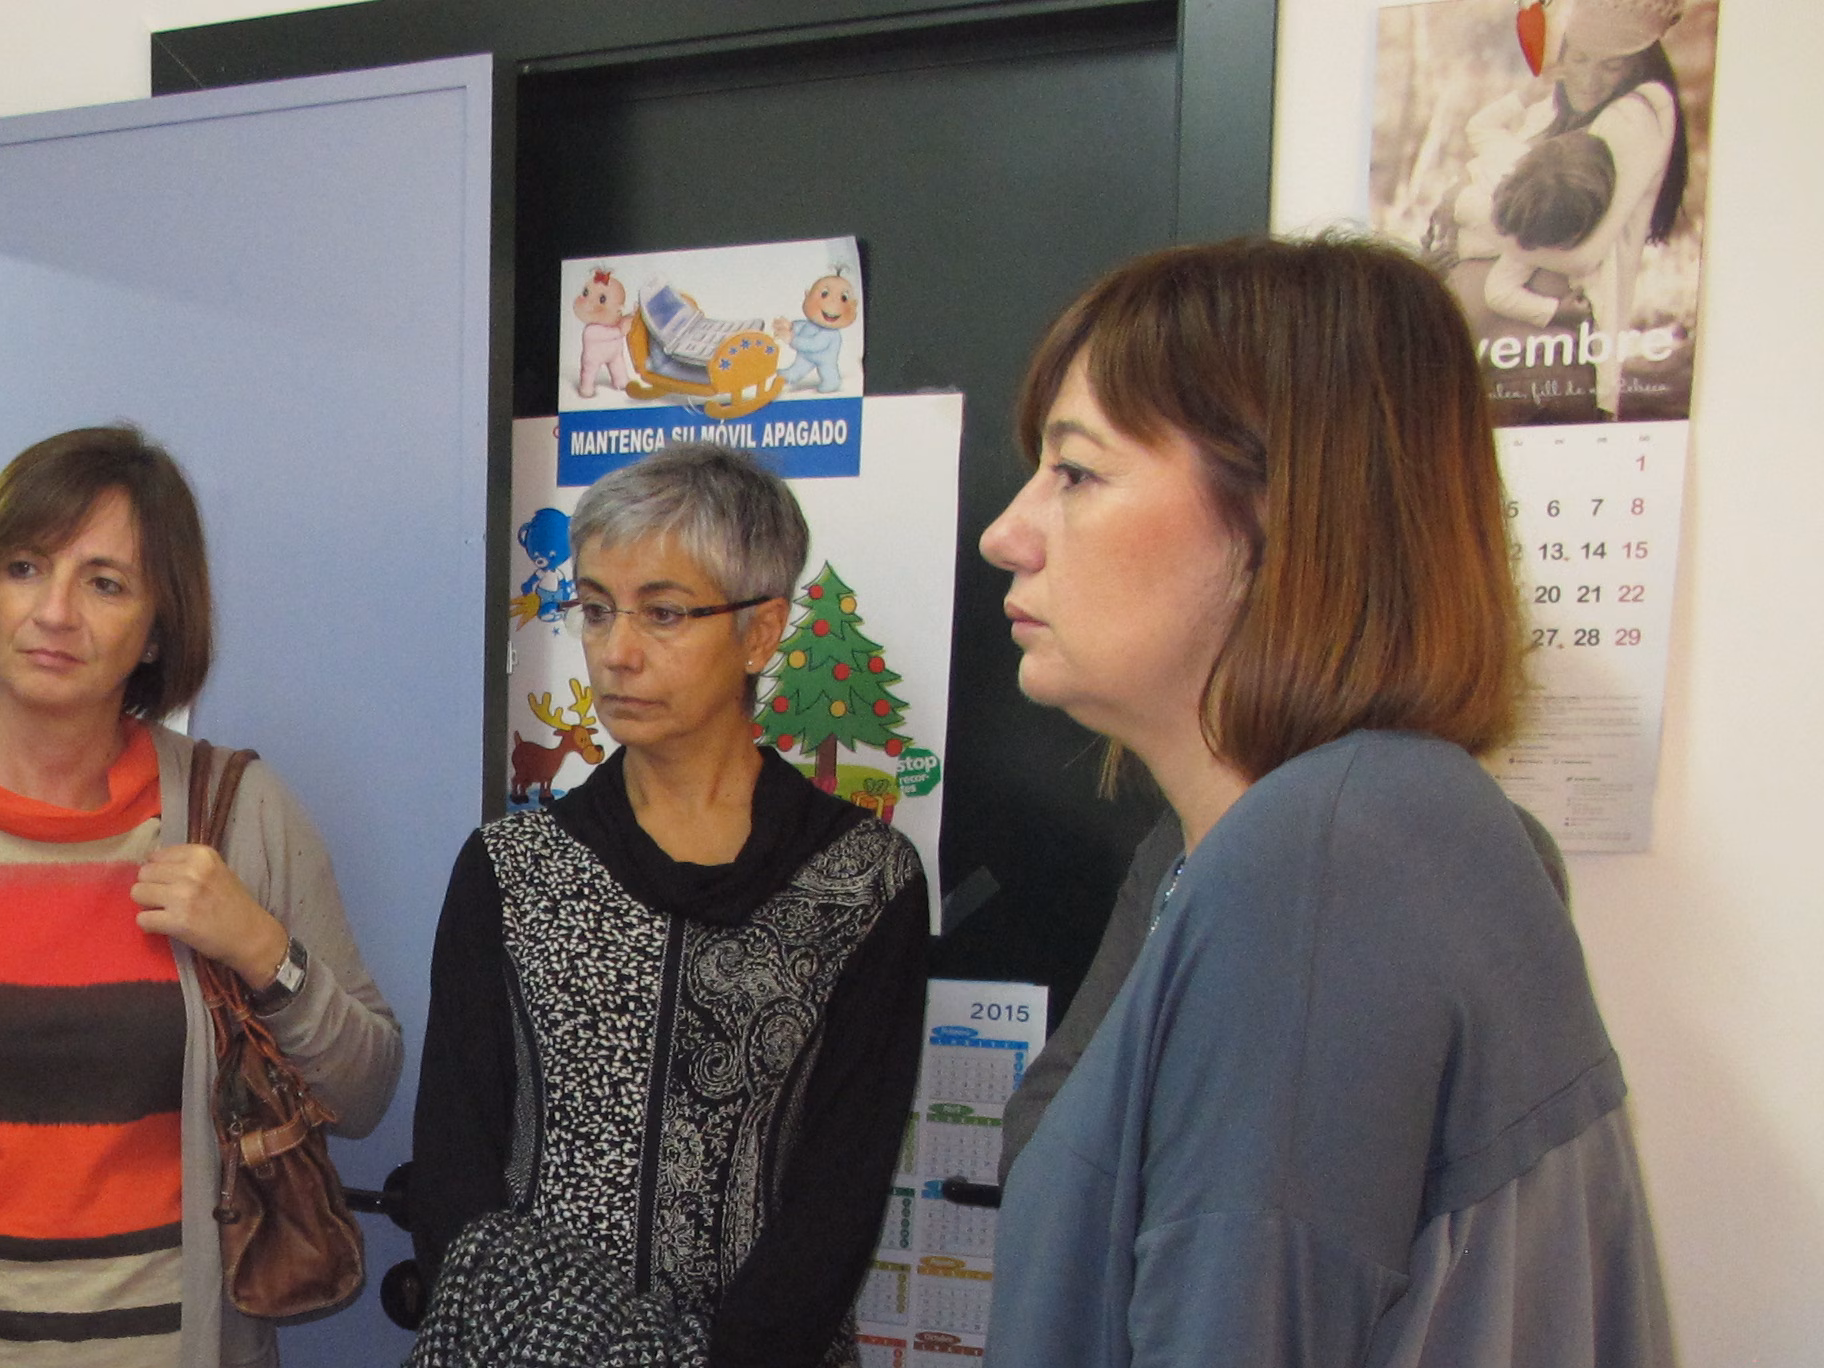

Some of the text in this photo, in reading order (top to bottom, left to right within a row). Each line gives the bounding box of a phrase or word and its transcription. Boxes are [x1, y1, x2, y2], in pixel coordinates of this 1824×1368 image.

[571, 419, 847, 456] MANTENGA SU MÓVIL APAGADO
[1636, 456, 1646, 472] 1
[1547, 500, 1561, 518] 6
[1591, 499, 1604, 517] 7
[1630, 497, 1644, 516] 8
[1538, 543, 1564, 561] 13
[1581, 542, 1607, 560] 14
[1622, 541, 1648, 559] 15
[1534, 585, 1645, 604] 20 21 22
[1532, 628, 1642, 646] 27 28 29
[970, 1003, 1030, 1022] 2015
